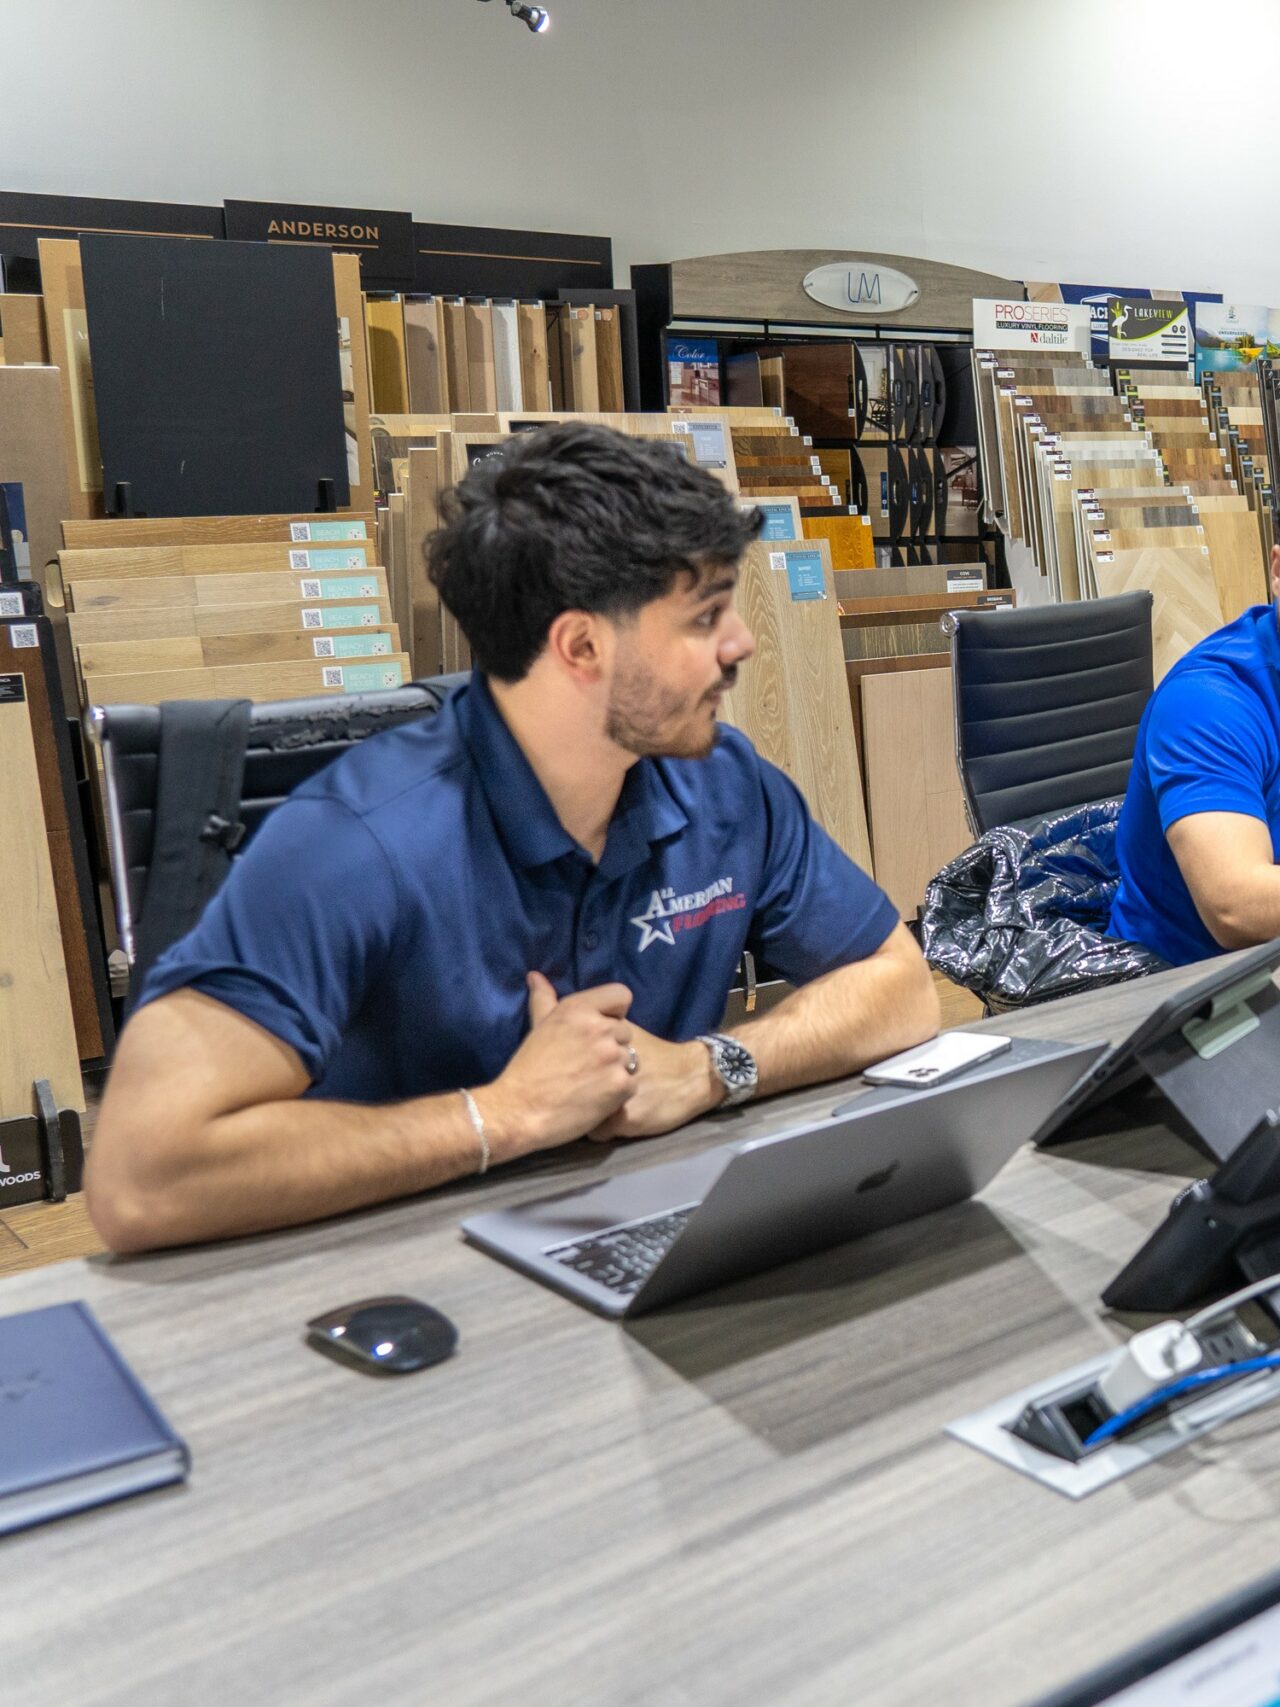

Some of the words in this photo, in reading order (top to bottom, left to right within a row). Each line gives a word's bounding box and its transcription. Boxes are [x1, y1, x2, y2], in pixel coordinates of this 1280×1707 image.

[267, 219, 380, 241] ANDERSON
[1134, 308, 1174, 319] LAKEVIEW
[996, 321, 1020, 329] LUXURY
[1021, 322, 1037, 330] VINYL
[1038, 323, 1069, 332] FLOORING
[1039, 333, 1067, 344] daltile
